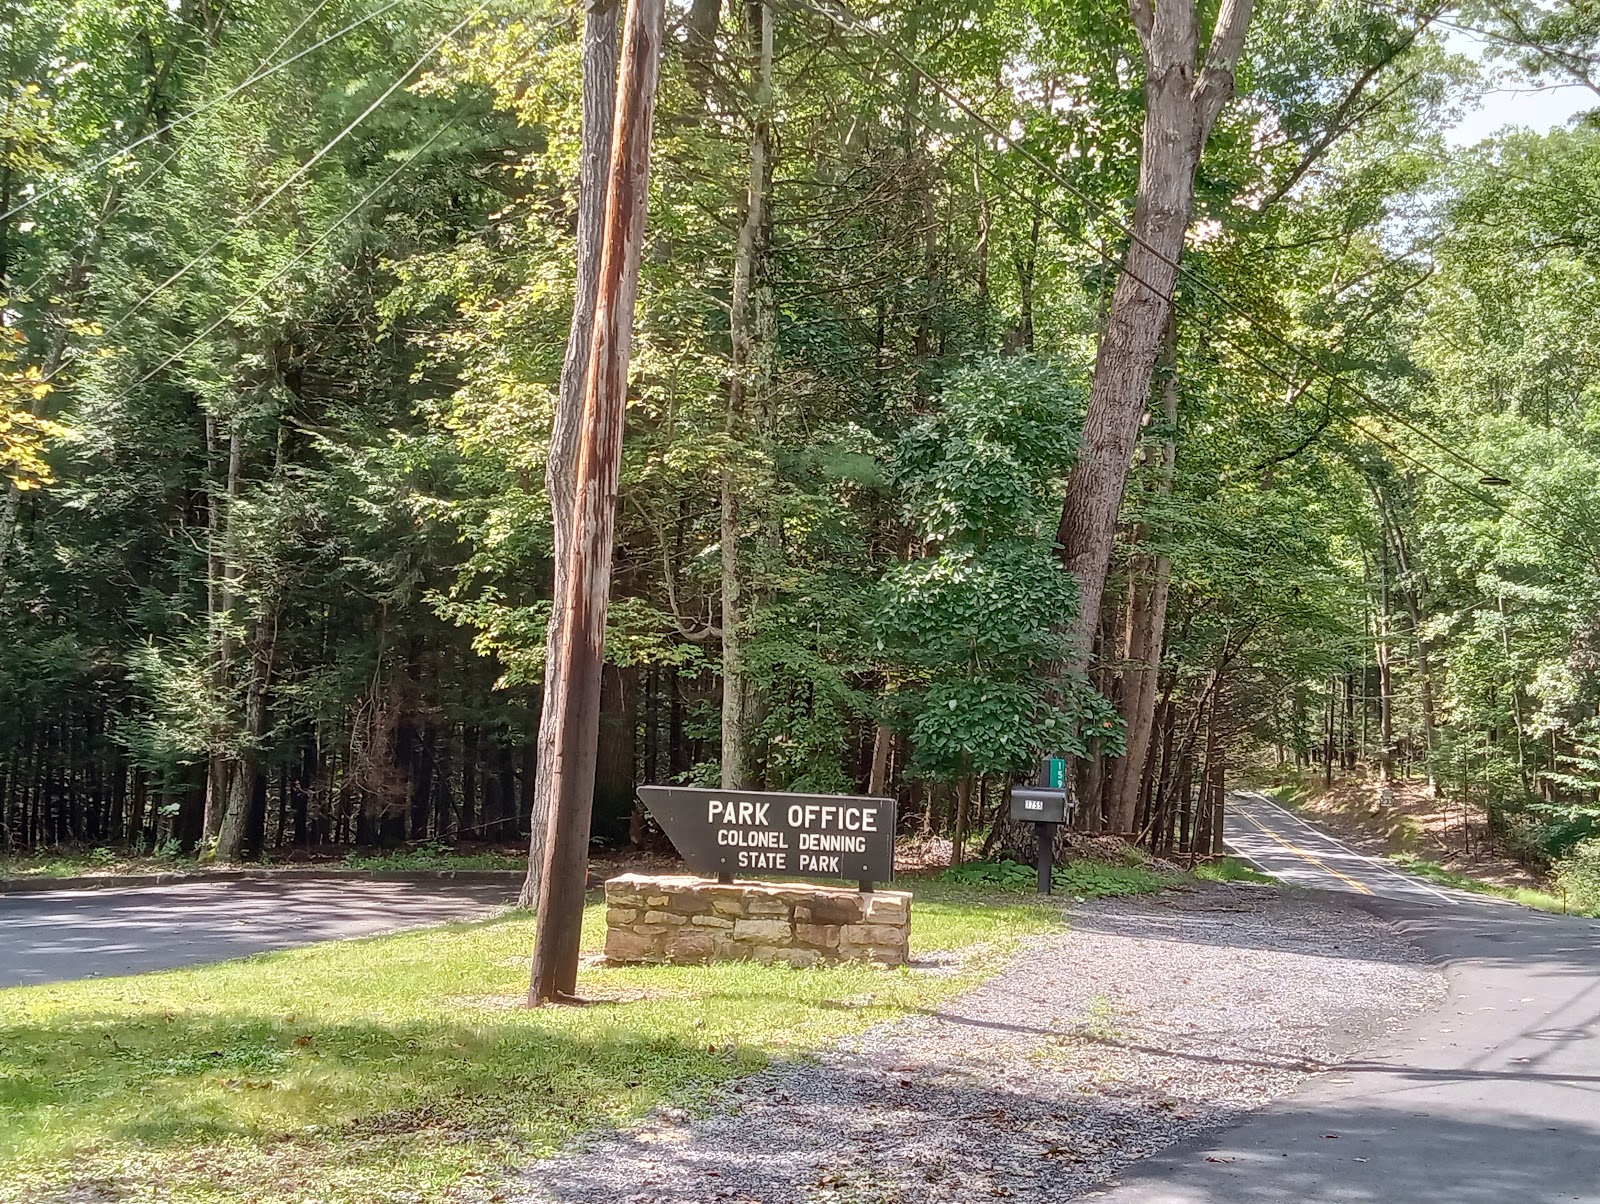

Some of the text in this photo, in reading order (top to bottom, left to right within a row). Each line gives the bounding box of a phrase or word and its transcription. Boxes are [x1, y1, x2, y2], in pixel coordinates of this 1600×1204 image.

[708, 800, 878, 832] PARK OFFICE
[717, 829, 866, 853] COLONEL DENNING
[738, 851, 839, 873] STATE PARK
